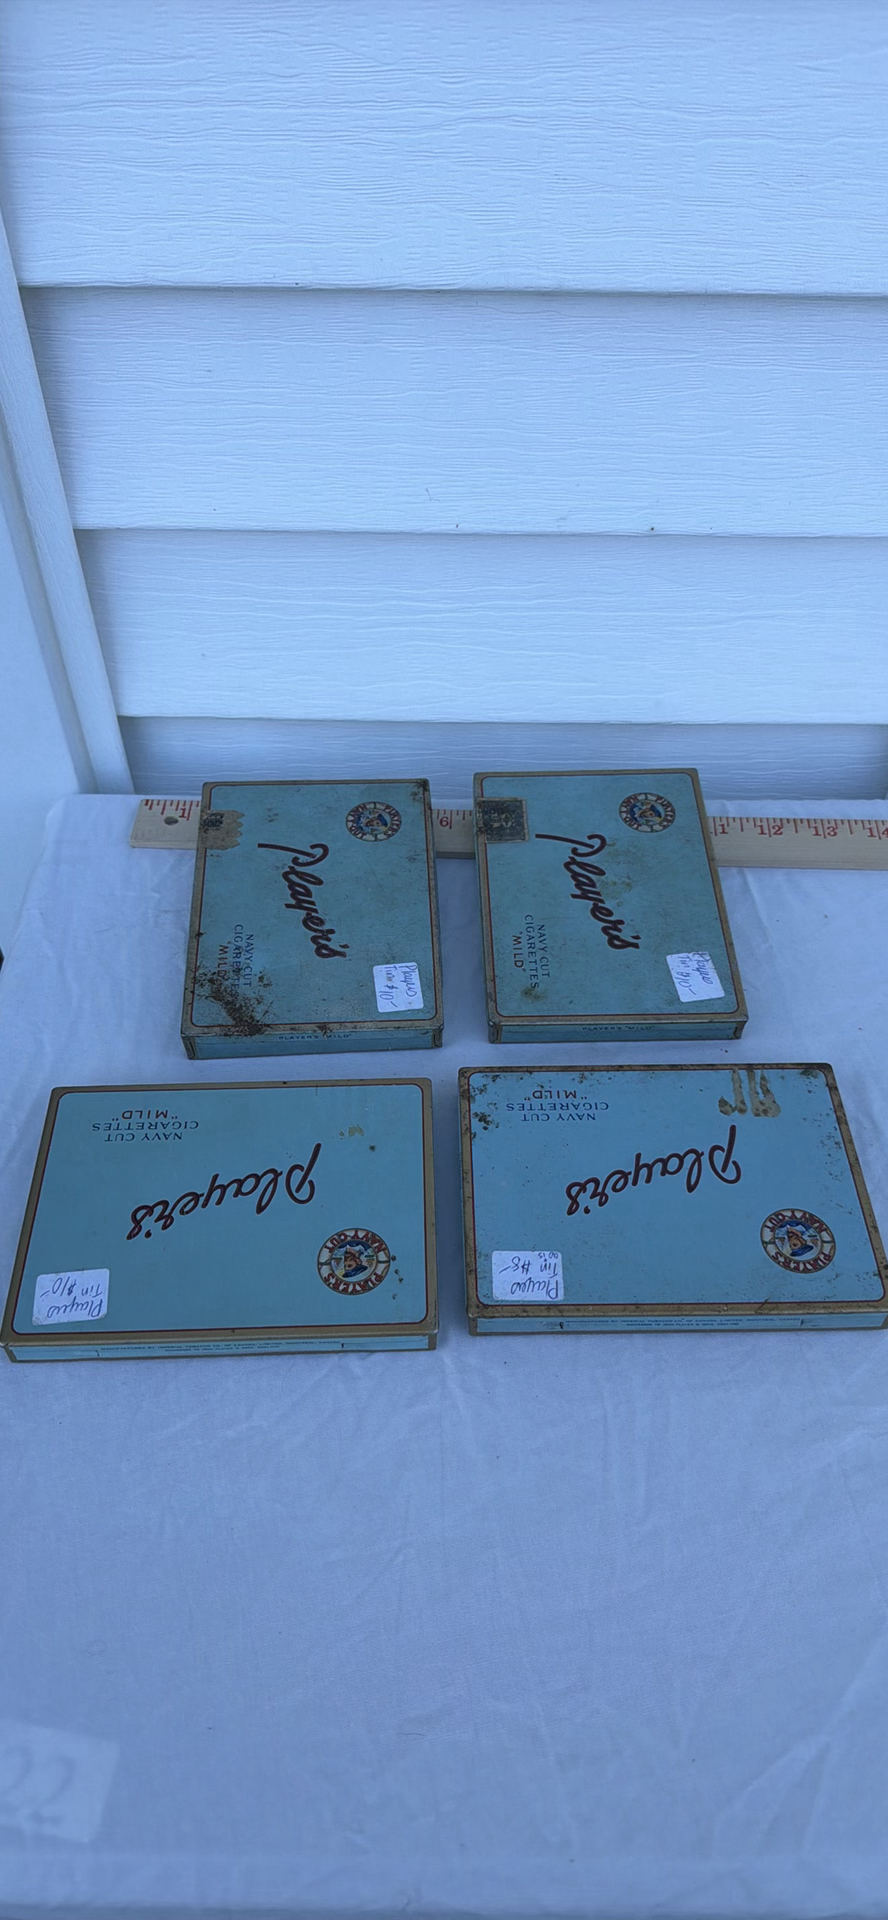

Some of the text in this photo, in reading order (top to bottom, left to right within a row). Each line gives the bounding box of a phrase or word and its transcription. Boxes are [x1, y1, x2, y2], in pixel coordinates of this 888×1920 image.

[438, 815, 450, 828] 6
[257, 843, 350, 958] Player's
[535, 833, 641, 950] Player's
[243, 933, 255, 988] NAVY CUT
[524, 914, 540, 989] CIGARETTES
[537, 924, 550, 978] NAVY CUT
[506, 1102, 609, 1112] CIGARETTES
[521, 1113, 596, 1122] NAVY CUT
[92, 1120, 199, 1132] CIGARETTES
[104, 1132, 183, 1142] NAVY CUT
[565, 1124, 742, 1216] Player's
[126, 1143, 321, 1240] Player's
[764, 1210, 828, 1234] NAVY CUT
[324, 1229, 387, 1254] NAVY CUT
[772, 1251, 831, 1272] PLAYER'S
[81, 1283, 103, 1298] Tin
[324, 1272, 384, 1294] PLAYER'S
